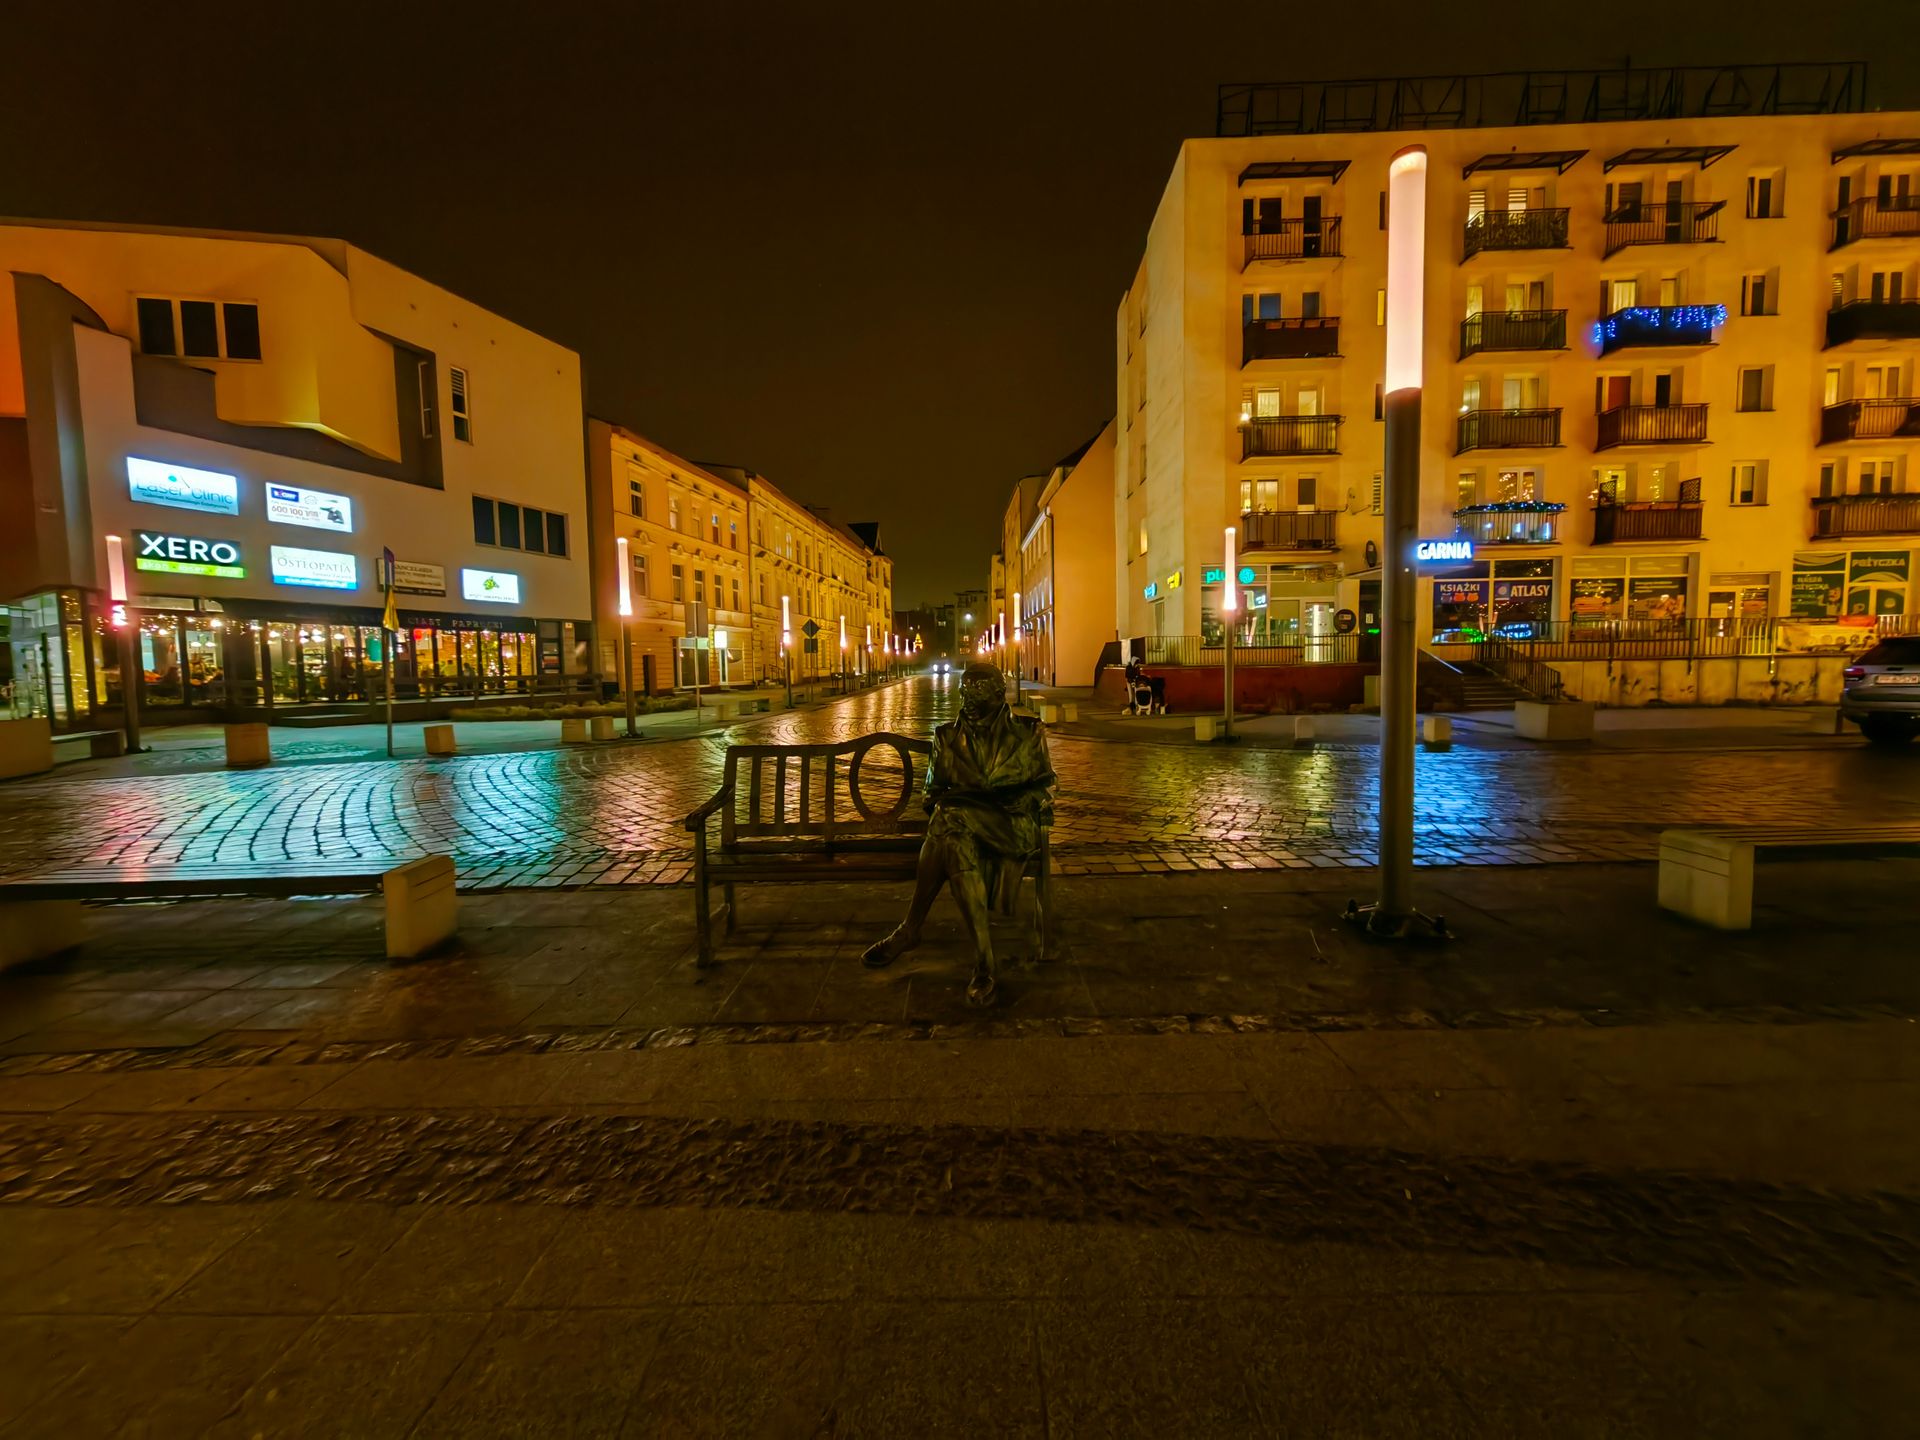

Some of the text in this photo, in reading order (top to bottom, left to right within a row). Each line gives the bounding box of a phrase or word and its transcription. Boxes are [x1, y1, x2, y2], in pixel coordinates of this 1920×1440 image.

[136, 478, 182, 496] Laser
[191, 486, 233, 504] Clinic
[140, 533, 237, 563] XERO
[1417, 541, 1473, 560] GARNIA
[1439, 582, 1480, 593] KSIĄŻKI
[1510, 584, 1551, 597] ATLASY
